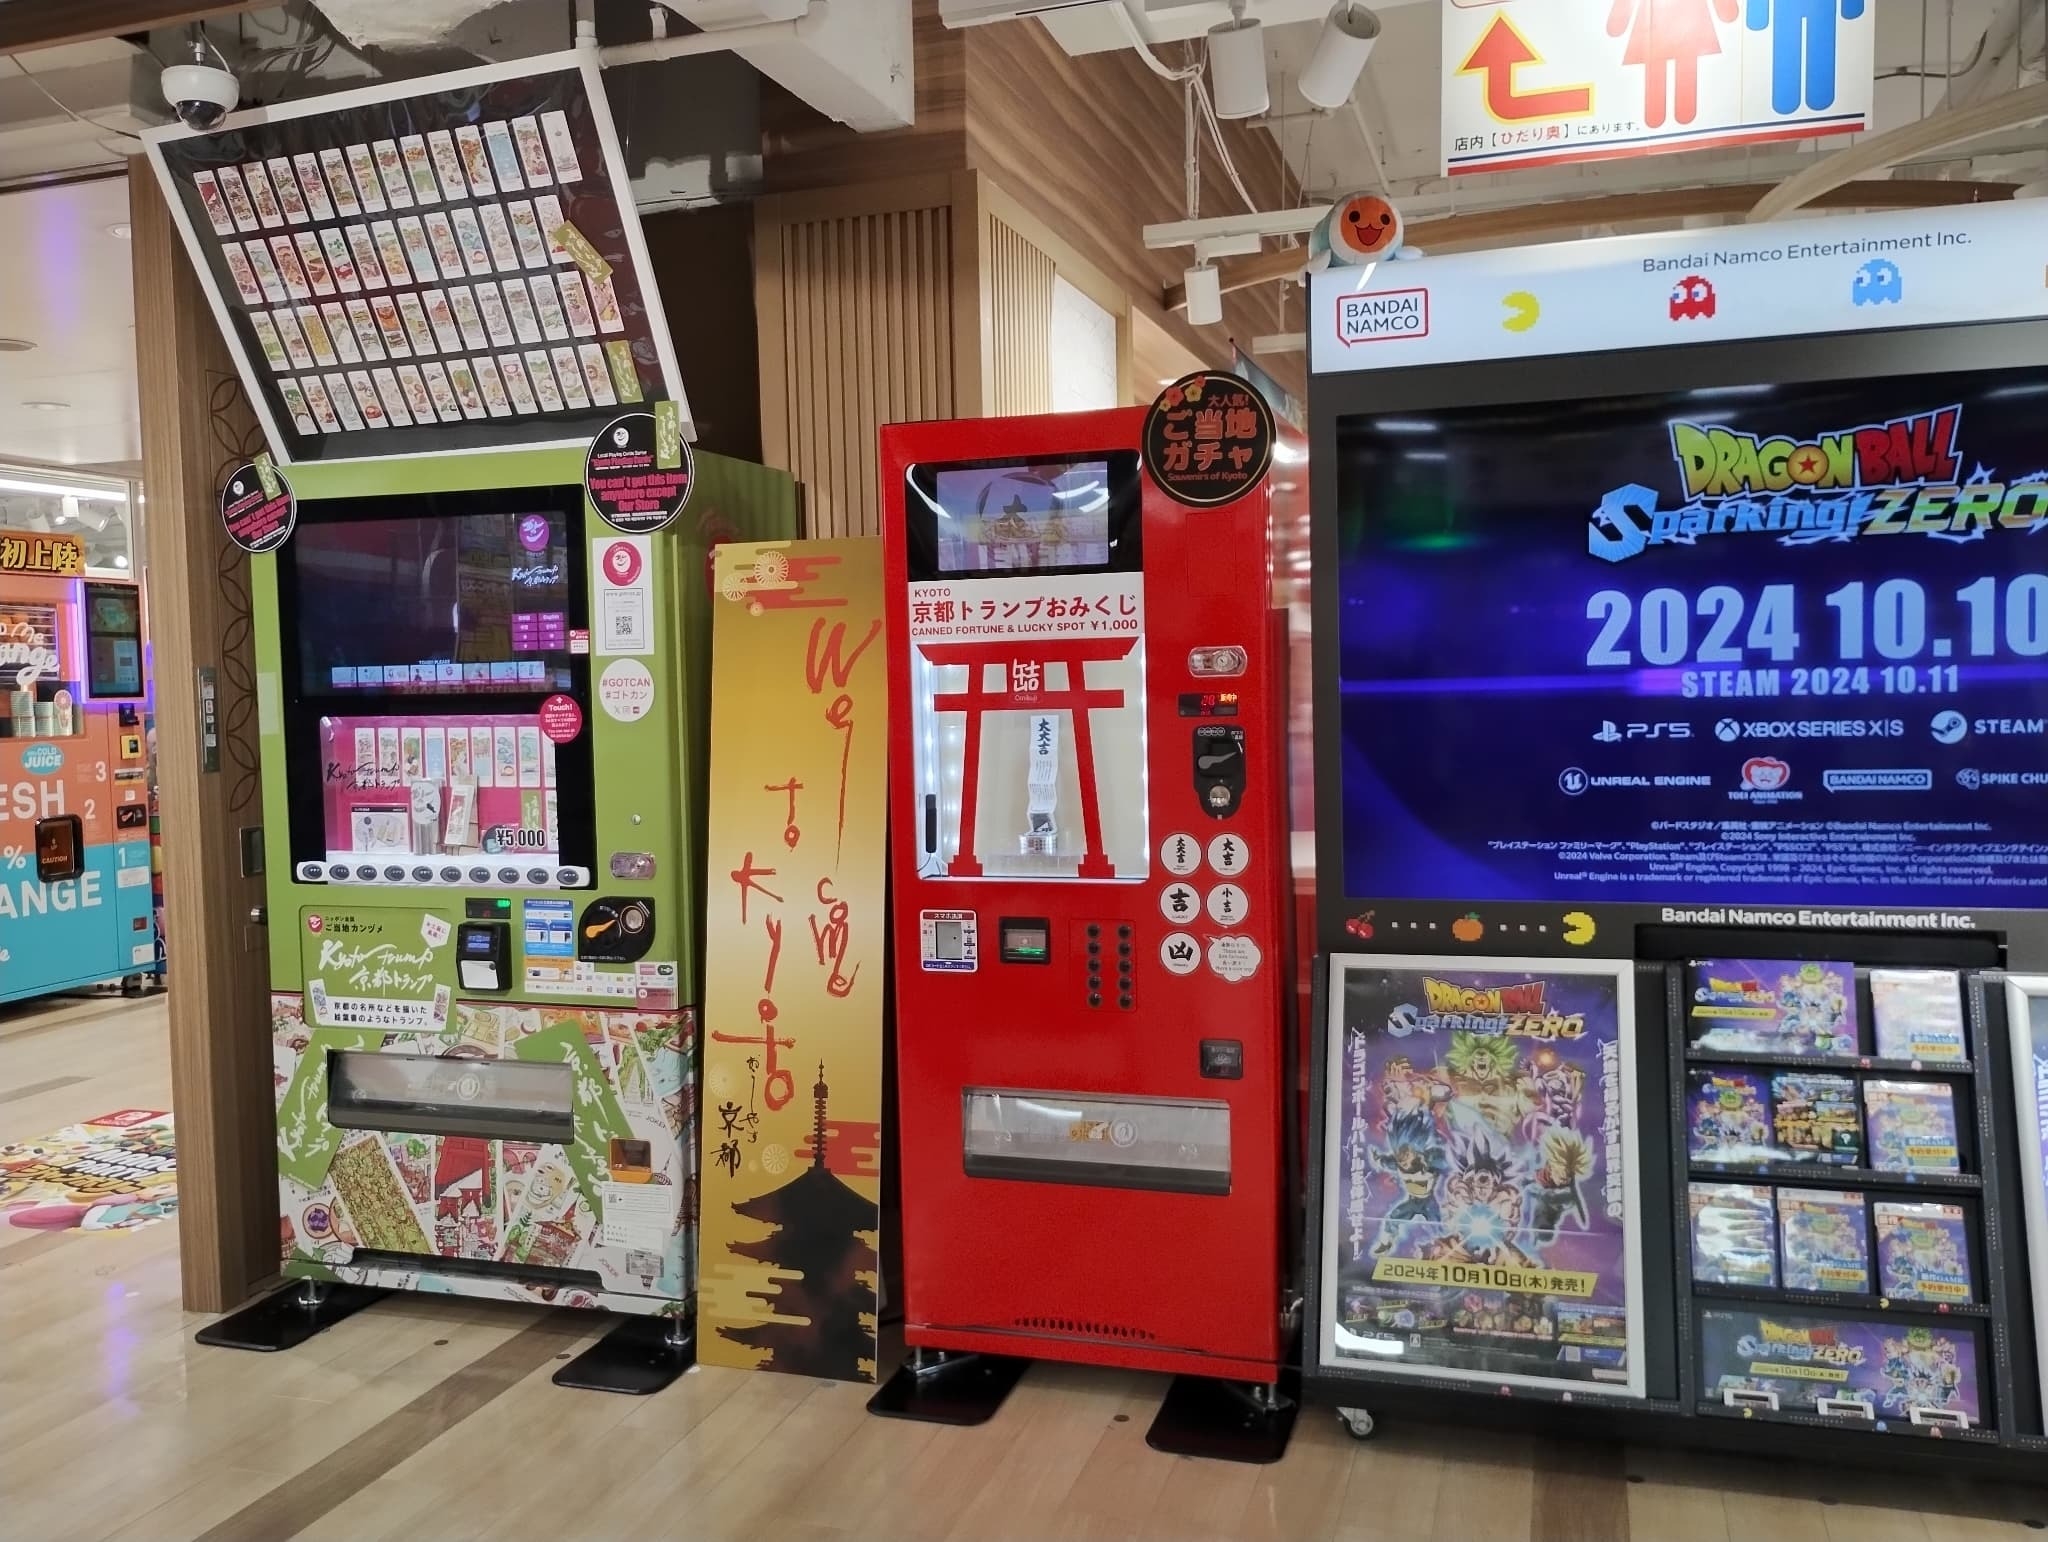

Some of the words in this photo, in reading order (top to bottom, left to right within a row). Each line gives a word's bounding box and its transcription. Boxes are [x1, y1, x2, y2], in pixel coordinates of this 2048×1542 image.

[1642, 251, 1709, 274] Bandai
[1713, 244, 1783, 268] Namco
[1788, 233, 1933, 261] Entertainment
[1937, 229, 1973, 247] Inc.
[1346, 297, 1420, 318] BANDAI
[1346, 313, 1420, 336] NAMCO
[1163, 408, 1257, 440] ご当地
[1163, 440, 1253, 471] ガチャ
[1672, 421, 1857, 499] DRAGON
[1853, 404, 1964, 487] BALL
[590, 478, 607, 490] You
[631, 476, 648, 488] get
[648, 473, 666, 486] this
[1167, 472, 1209, 481] Souvenirs
[1209, 471, 1221, 480] of
[1221, 471, 1248, 482] Kyoto
[600, 488, 646, 502] anywhere
[646, 486, 677, 499] except
[618, 501, 635, 512] Our
[635, 500, 660, 511] Store
[1861, 480, 2048, 545] ZERO
[0, 537, 79, 572] 初上陸
[914, 588, 951, 597] KYOTO
[912, 594, 1137, 624] 京都トランプおみくじ
[911, 626, 953, 636] CANNED
[955, 624, 1005, 634] FORTUNE
[1007, 624, 1015, 633] &
[1017, 622, 1053, 632] LUCKY
[1057, 621, 1086, 631] SPOT
[1090, 619, 1138, 632] ¥1,000
[1585, 584, 1799, 667] 2024
[1825, 573, 2048, 660] 10.10
[602, 677, 650, 688] #GOTCAN
[1681, 669, 1780, 698] STEAM
[1790, 667, 1871, 697] 2024
[1880, 664, 1959, 695] 10.11
[605, 690, 648, 700] #ゴトカン
[548, 703, 573, 711] Touch!
[1037, 717, 1052, 756] 大大吉
[1626, 721, 1692, 738] PS5
[1742, 721, 1797, 738] XBOX
[1797, 720, 1866, 738] SERIES
[1974, 718, 2044, 736] STEAM
[23, 754, 62, 769] JUICE
[95, 761, 107, 782] 3
[1590, 776, 1650, 787] UNREAL
[1654, 775, 1711, 786] ENGINE
[1829, 774, 1877, 786] BANDAI
[1877, 775, 1926, 786] NAMCO
[1981, 773, 2018, 784] SPIKE
[1728, 791, 1748, 800] TOEI
[1749, 791, 1803, 800] ANIMATION
[84, 798, 96, 820] 2
[496, 828, 546, 848] ¥5,000
[41, 855, 68, 865] CAUTION
[118, 847, 127, 867] 1
[1176, 836, 1186, 864] 大大吉
[1222, 837, 1235, 866] 大吉
[1588, 872, 1618, 883] Engine
[1619, 872, 1628, 881] is
[1635, 872, 1682, 882] trademark
[1682, 874, 1694, 882] or
[1694, 873, 1741, 884] registered
[1742, 873, 1790, 883] trademark
[1791, 874, 1802, 883] of
[1908, 875, 1941, 885] United
[1941, 875, 1973, 885] States
[1973, 876, 1986, 885] of
[1986, 876, 2028, 886] America
[2028, 877, 2048, 886] and
[1169, 887, 1191, 913] 吉
[1222, 887, 1233, 913] 小吉
[325, 923, 384, 934] ご当地カンヅメ
[1661, 908, 1726, 924] Bandai
[1727, 909, 1797, 927] Namco
[1798, 910, 1939, 929] Entertainment
[1940, 912, 1977, 929] Inc.
[318, 938, 368, 971] Kyoto
[366, 943, 434, 971] Trump
[1168, 940, 1194, 961] 凶
[349, 966, 433, 997] 京都トランプ
[711, 851, 796, 1112] Kyoto
[1423, 977, 1501, 1015] DRAGON
[1500, 981, 1546, 1015] BALL
[334, 1001, 428, 1015] 京都の名所などを描いた
[1506, 1012, 1586, 1041] ZERO
[710, 1101, 744, 1178] 京都
[1383, 1264, 1586, 1293] 2024年10月10日(木)発売!
